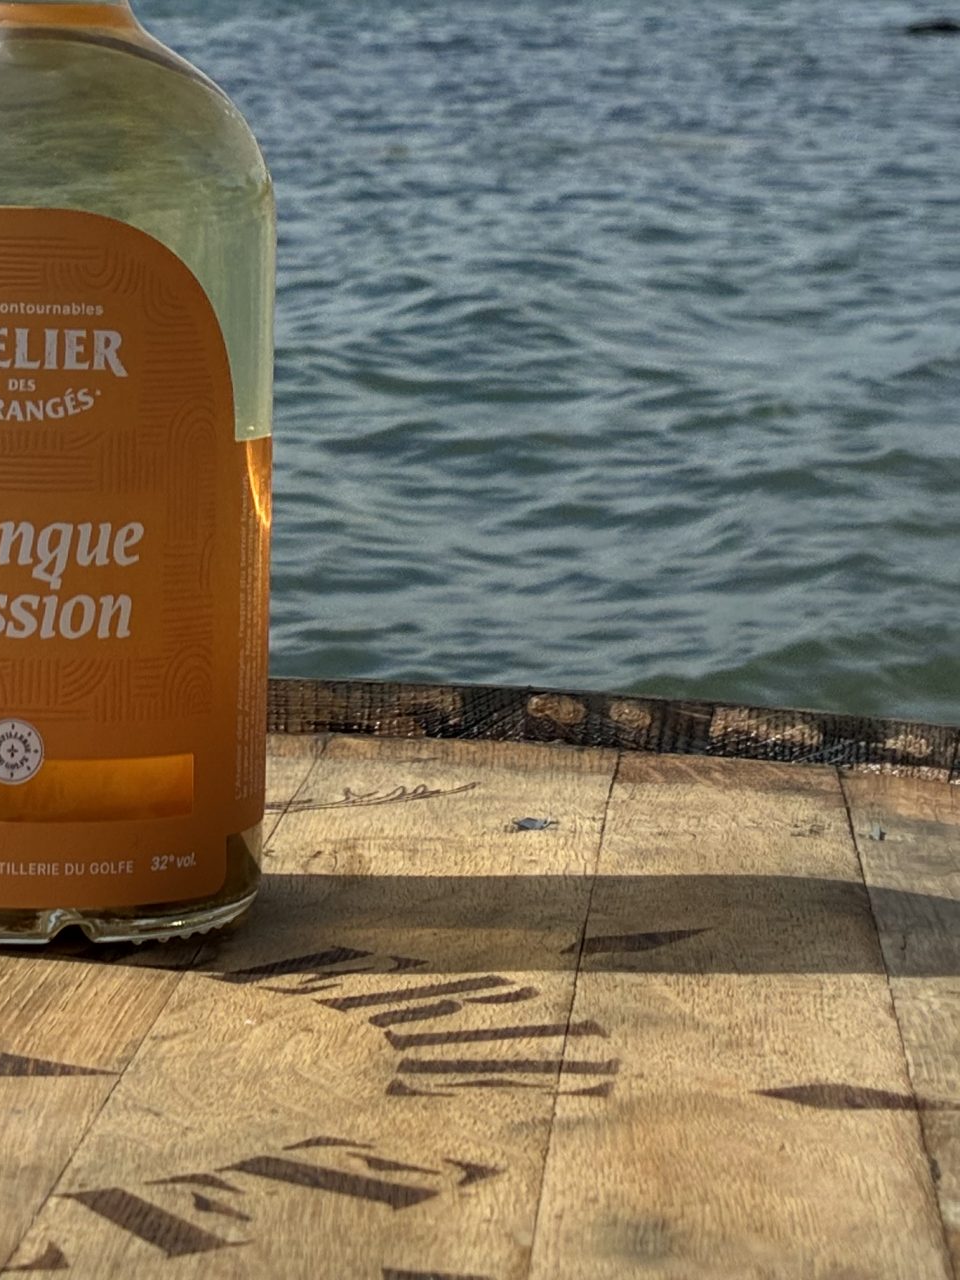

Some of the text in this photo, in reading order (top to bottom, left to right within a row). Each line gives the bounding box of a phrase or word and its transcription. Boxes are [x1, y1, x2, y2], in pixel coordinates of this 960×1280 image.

[8, 378, 36, 391] DES
[64, 862, 85, 876] DU
[90, 860, 134, 875] GOLFE
